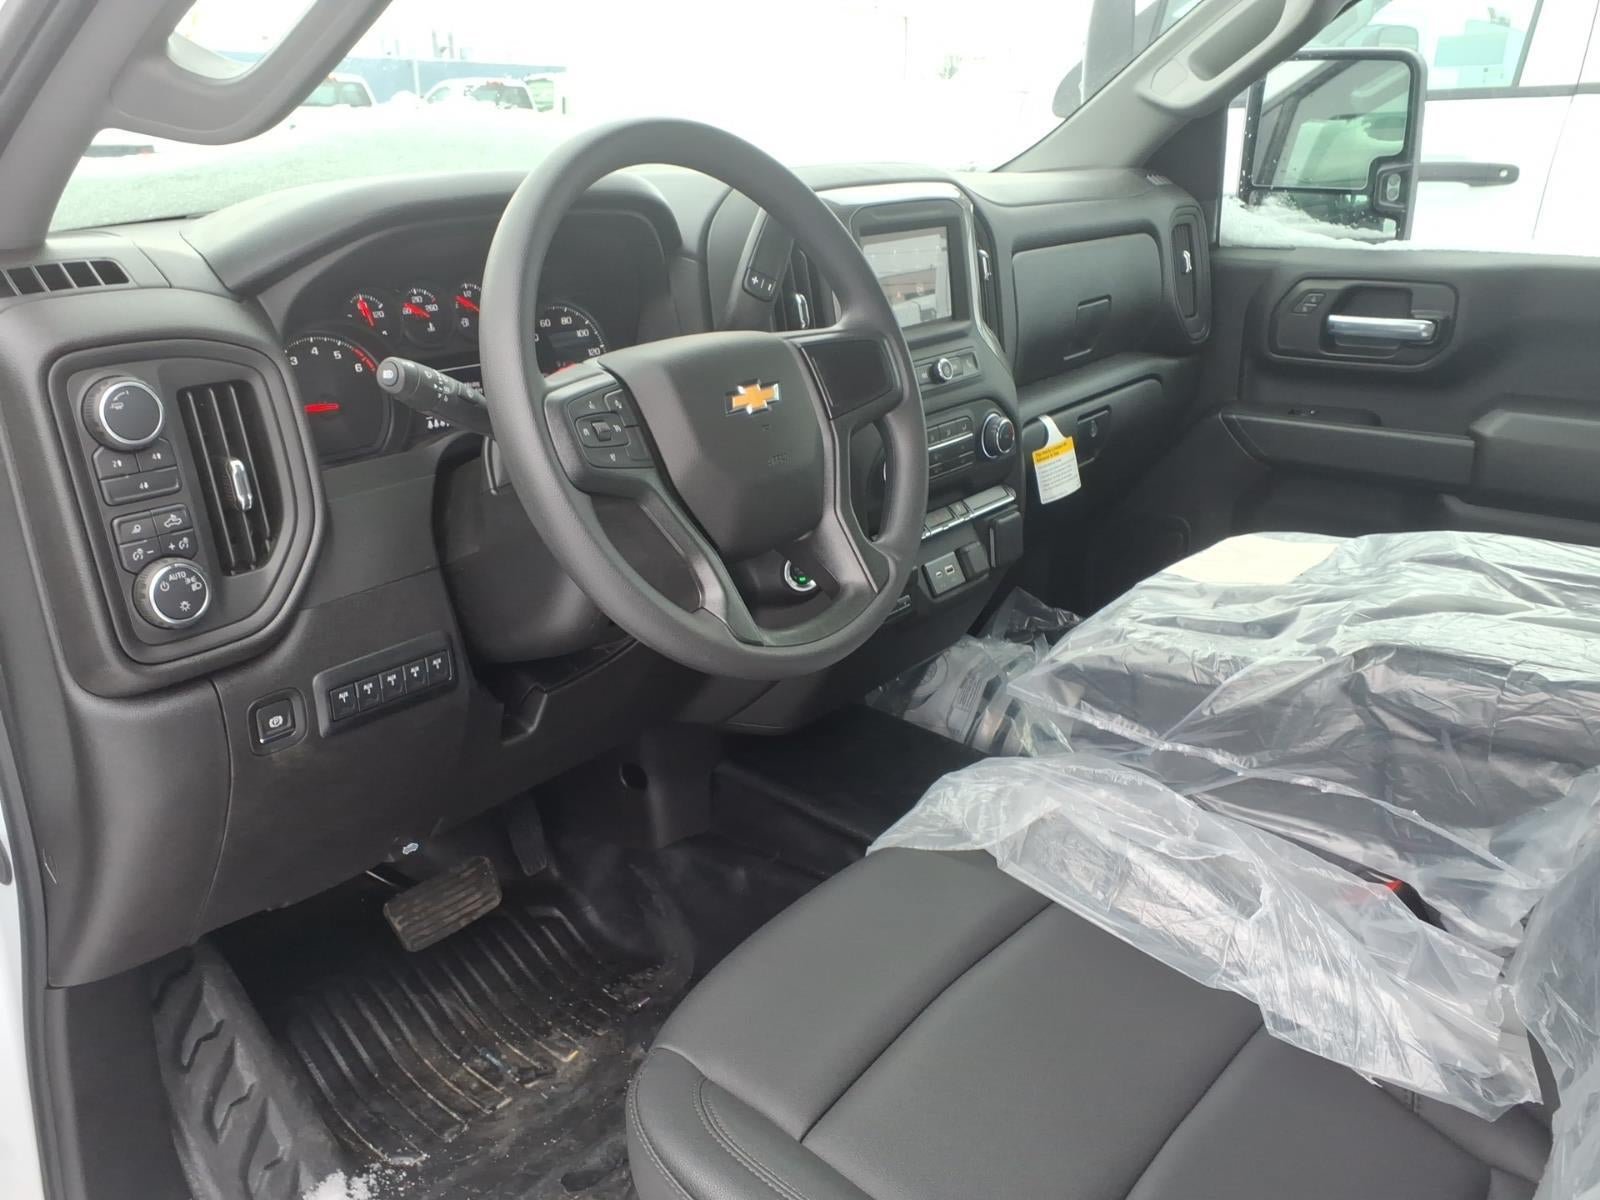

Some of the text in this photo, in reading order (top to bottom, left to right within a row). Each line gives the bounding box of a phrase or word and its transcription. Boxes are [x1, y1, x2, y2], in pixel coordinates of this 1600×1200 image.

[539, 319, 551, 328] 60
[560, 316, 572, 325] 80
[576, 329, 590, 337] 100
[311, 346, 319, 355] 4
[333, 350, 342, 359] 5
[588, 347, 601, 357] 120
[289, 356, 298, 365] 3
[354, 363, 363, 372] 6
[169, 571, 186, 581] AUTO
